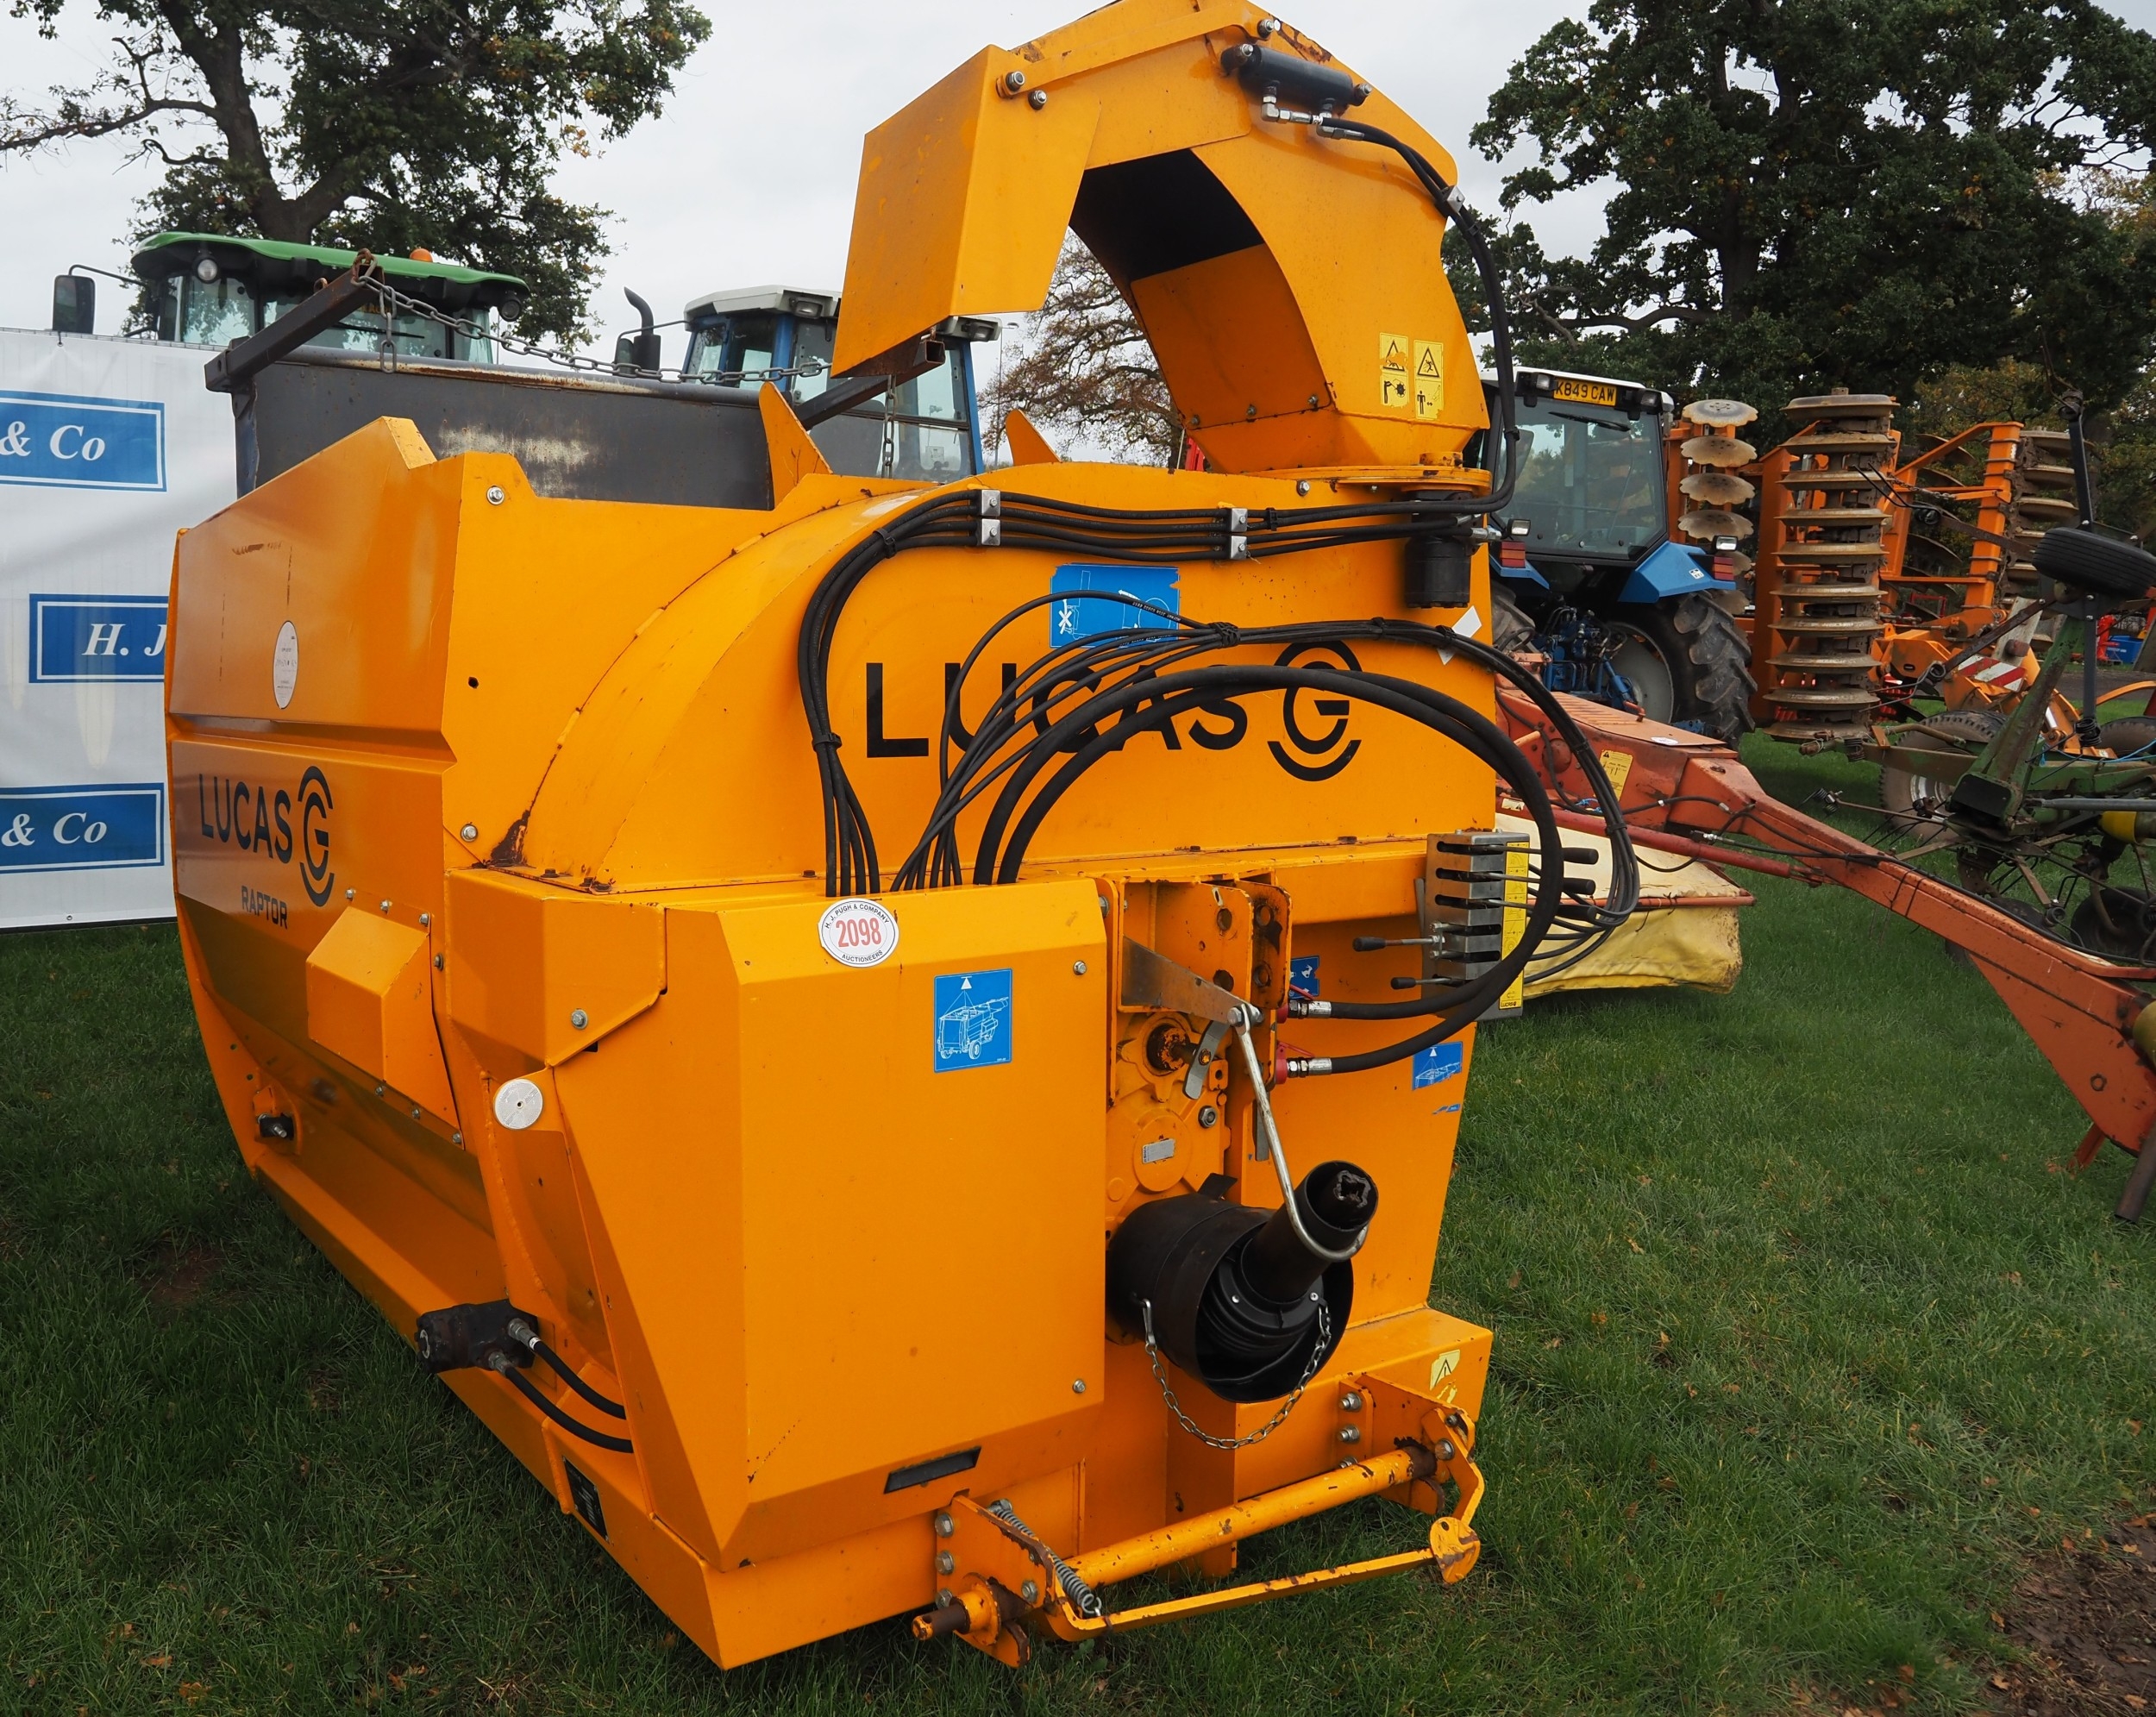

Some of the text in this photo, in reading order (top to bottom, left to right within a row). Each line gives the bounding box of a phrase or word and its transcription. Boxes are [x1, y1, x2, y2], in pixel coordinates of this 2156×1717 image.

[1555, 381, 1614, 402] K849 CAW
[0, 420, 105, 461] & Co
[81, 624, 129, 656] H.
[866, 662, 1248, 758] LUCAS
[1, 812, 107, 847] & Co
[198, 774, 293, 864] LUCAS
[241, 885, 288, 930] RAPTOR
[835, 904, 852, 916] PUGH
[859, 903, 890, 924] COMPANY
[835, 918, 882, 947] 2098
[842, 949, 883, 962] AUCTIONEERS
